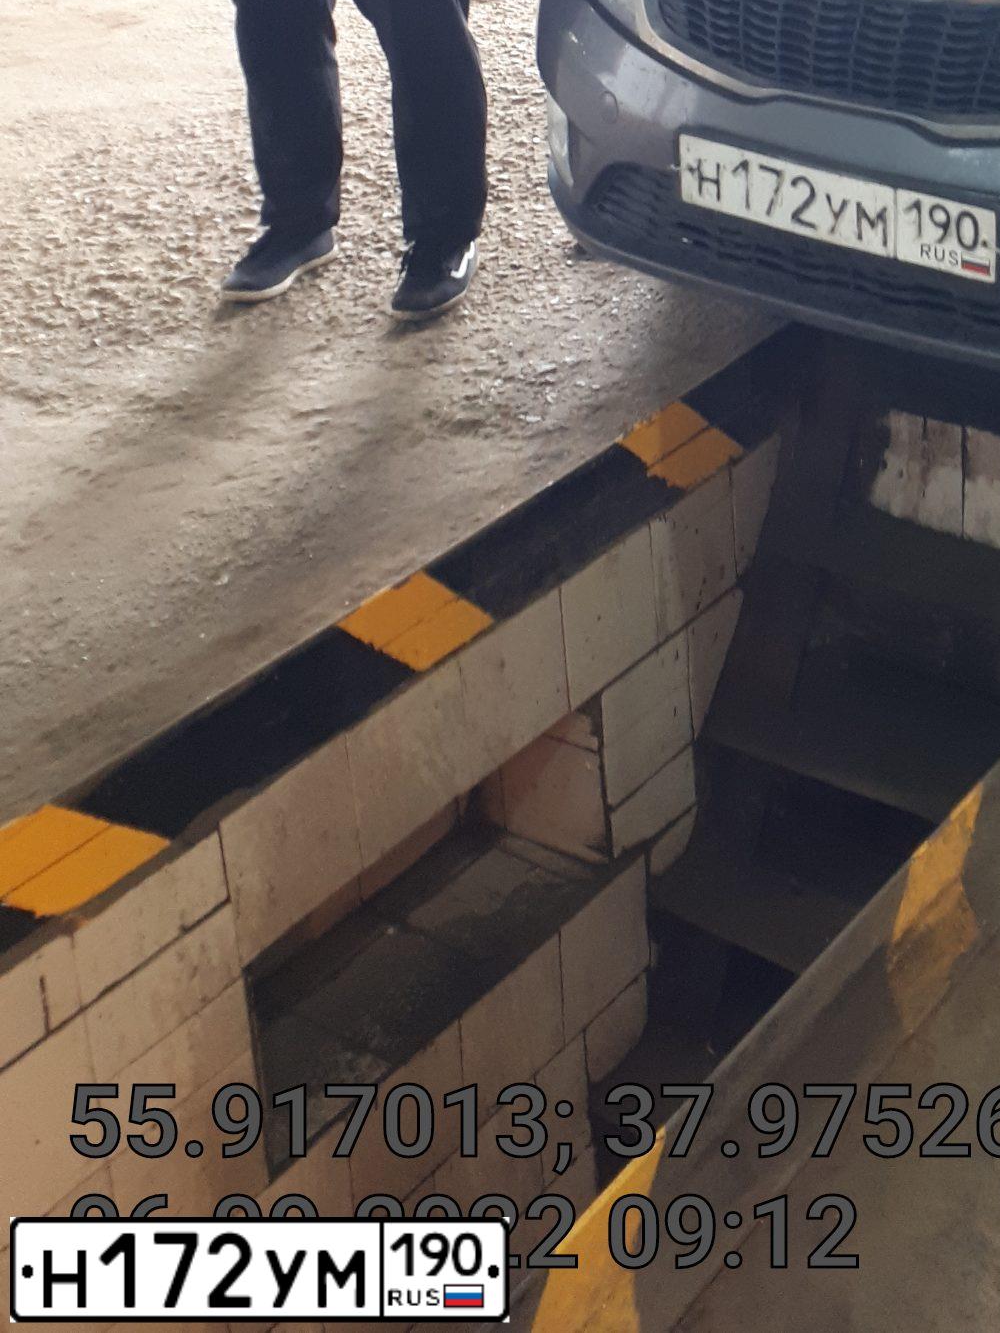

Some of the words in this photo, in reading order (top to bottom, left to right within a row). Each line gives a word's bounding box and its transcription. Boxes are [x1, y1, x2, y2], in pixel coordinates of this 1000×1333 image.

[695, 157, 889, 248] Н172УМ
[903, 198, 980, 250] 190
[919, 242, 960, 267] RUS
